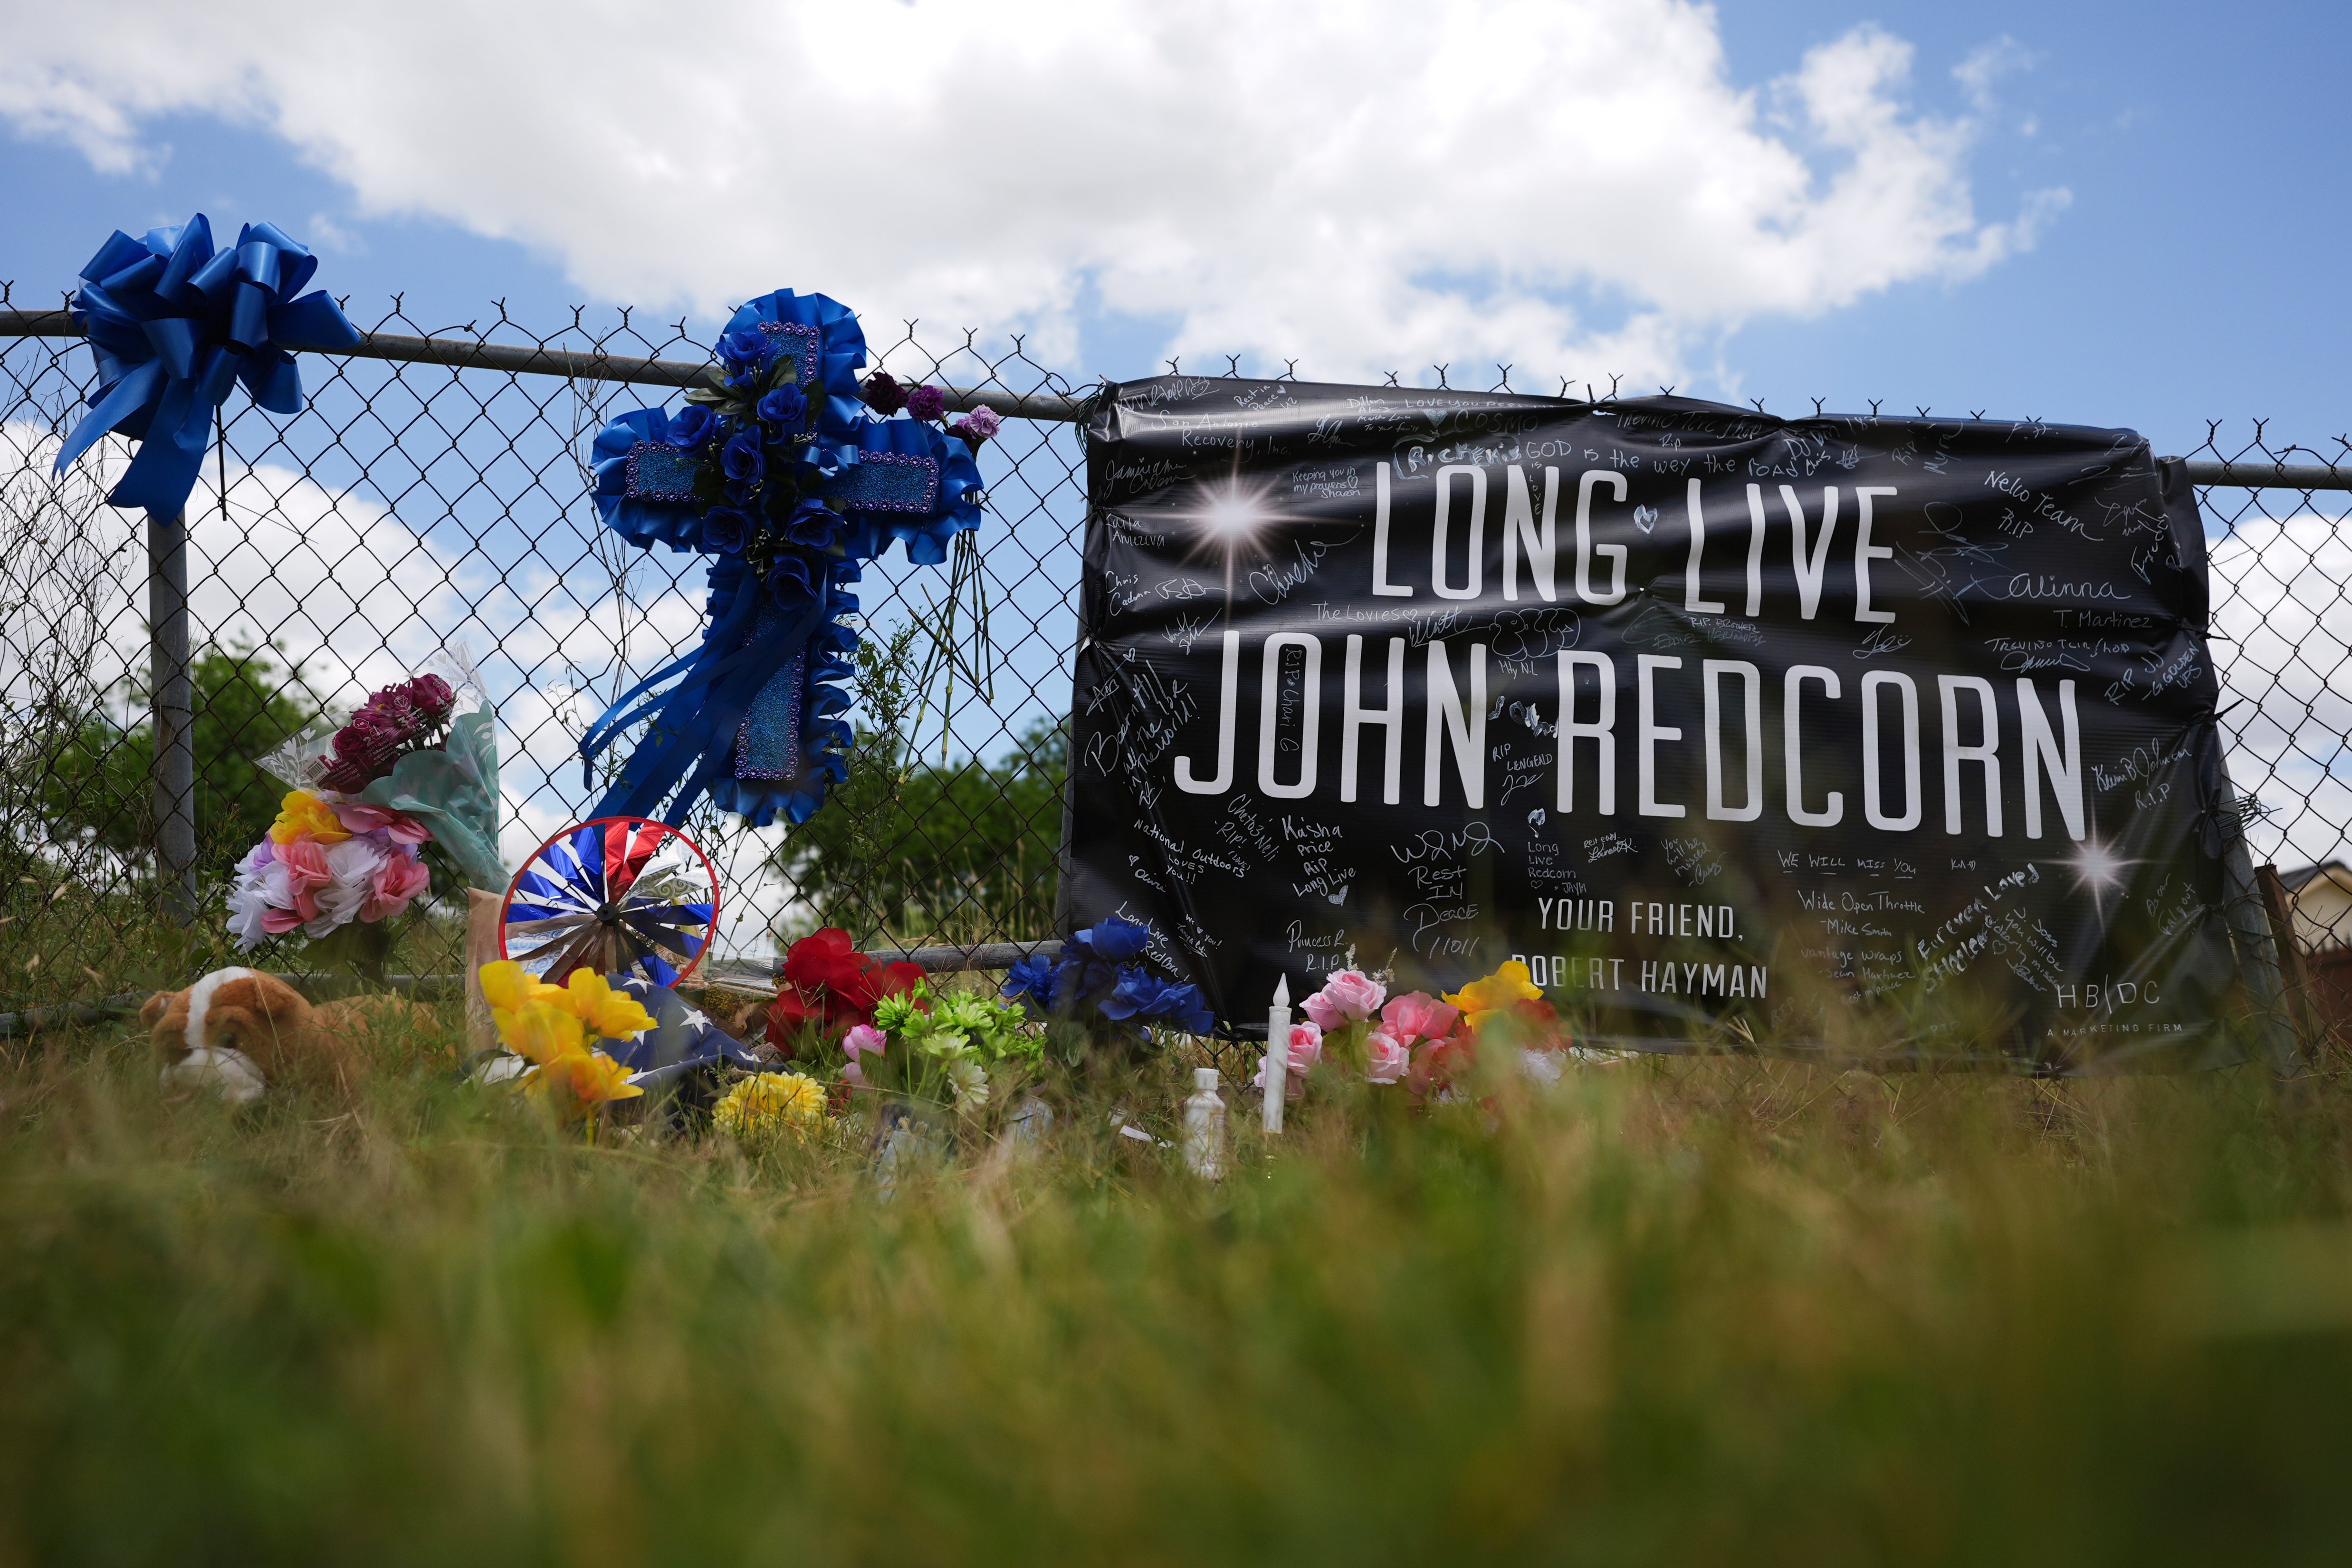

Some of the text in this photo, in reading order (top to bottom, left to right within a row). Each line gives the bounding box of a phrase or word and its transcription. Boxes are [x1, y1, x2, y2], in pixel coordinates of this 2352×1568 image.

[1234, 384, 1271, 407] Rest in
[1248, 393, 1279, 412] Peace
[1151, 410, 1259, 430] San Antonio
[1268, 435, 1292, 455] Inc.
[1526, 439, 1572, 459] GOD
[1609, 448, 1640, 468] the
[1703, 453, 1735, 473] the
[1292, 468, 1326, 483] Keeping
[1293, 480, 1347, 494] my prayers
[2033, 492, 2103, 542] Team
[1371, 461, 1627, 606] LONG
[1685, 478, 1898, 623] LIVE
[1105, 570, 1139, 593] Chris
[1310, 600, 1340, 621] The
[2053, 610, 2153, 628] T. Martinez
[397, 716, 409, 727] 3
[363, 736, 374, 746] 2
[1174, 631, 2086, 841] JOHN REDCORN
[373, 742, 393, 755] lukewarm
[1492, 743, 1511, 762] RIP
[339, 761, 350, 769] clean
[1133, 818, 1245, 879] National Outdoors
[1528, 841, 1559, 856] Long
[1777, 850, 1799, 868] WE
[1808, 854, 1845, 867] WILL
[1292, 867, 1356, 897] Long Live
[1407, 865, 1468, 889] Rest
[1527, 867, 1577, 880] Redcorn
[1797, 889, 1925, 914] Wide Open Throttle
[1538, 897, 1743, 942] YOUR FRIEND,
[1286, 919, 1331, 953] Princess
[1861, 923, 1892, 937] Smith
[1511, 954, 1767, 999] OBERT HAYMAN
[2047, 1023, 2182, 1037] A MARKETING FIRM
